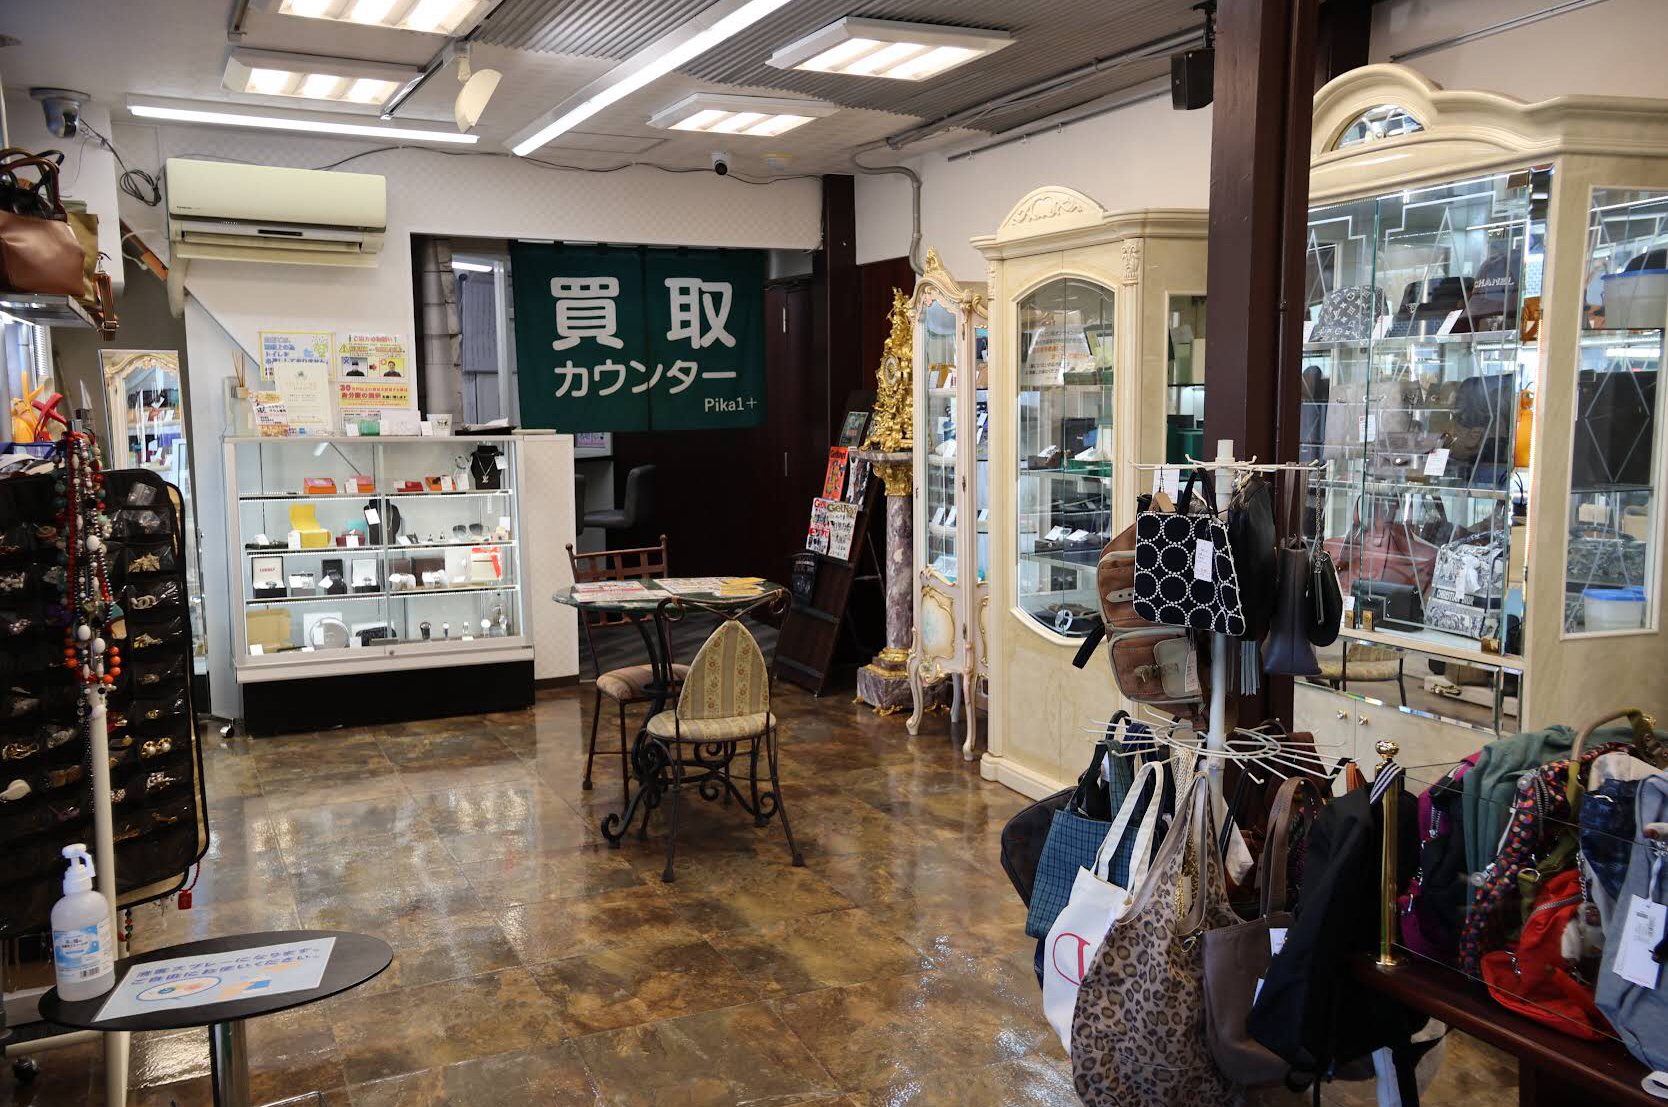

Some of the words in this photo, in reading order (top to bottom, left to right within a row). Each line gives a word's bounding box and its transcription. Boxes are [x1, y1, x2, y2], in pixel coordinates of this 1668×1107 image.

[1474, 276, 1514, 289] CHANEL
[551, 277, 736, 350] 買取
[554, 359, 737, 398] カウンター
[704, 397, 757, 412] Pika1+
